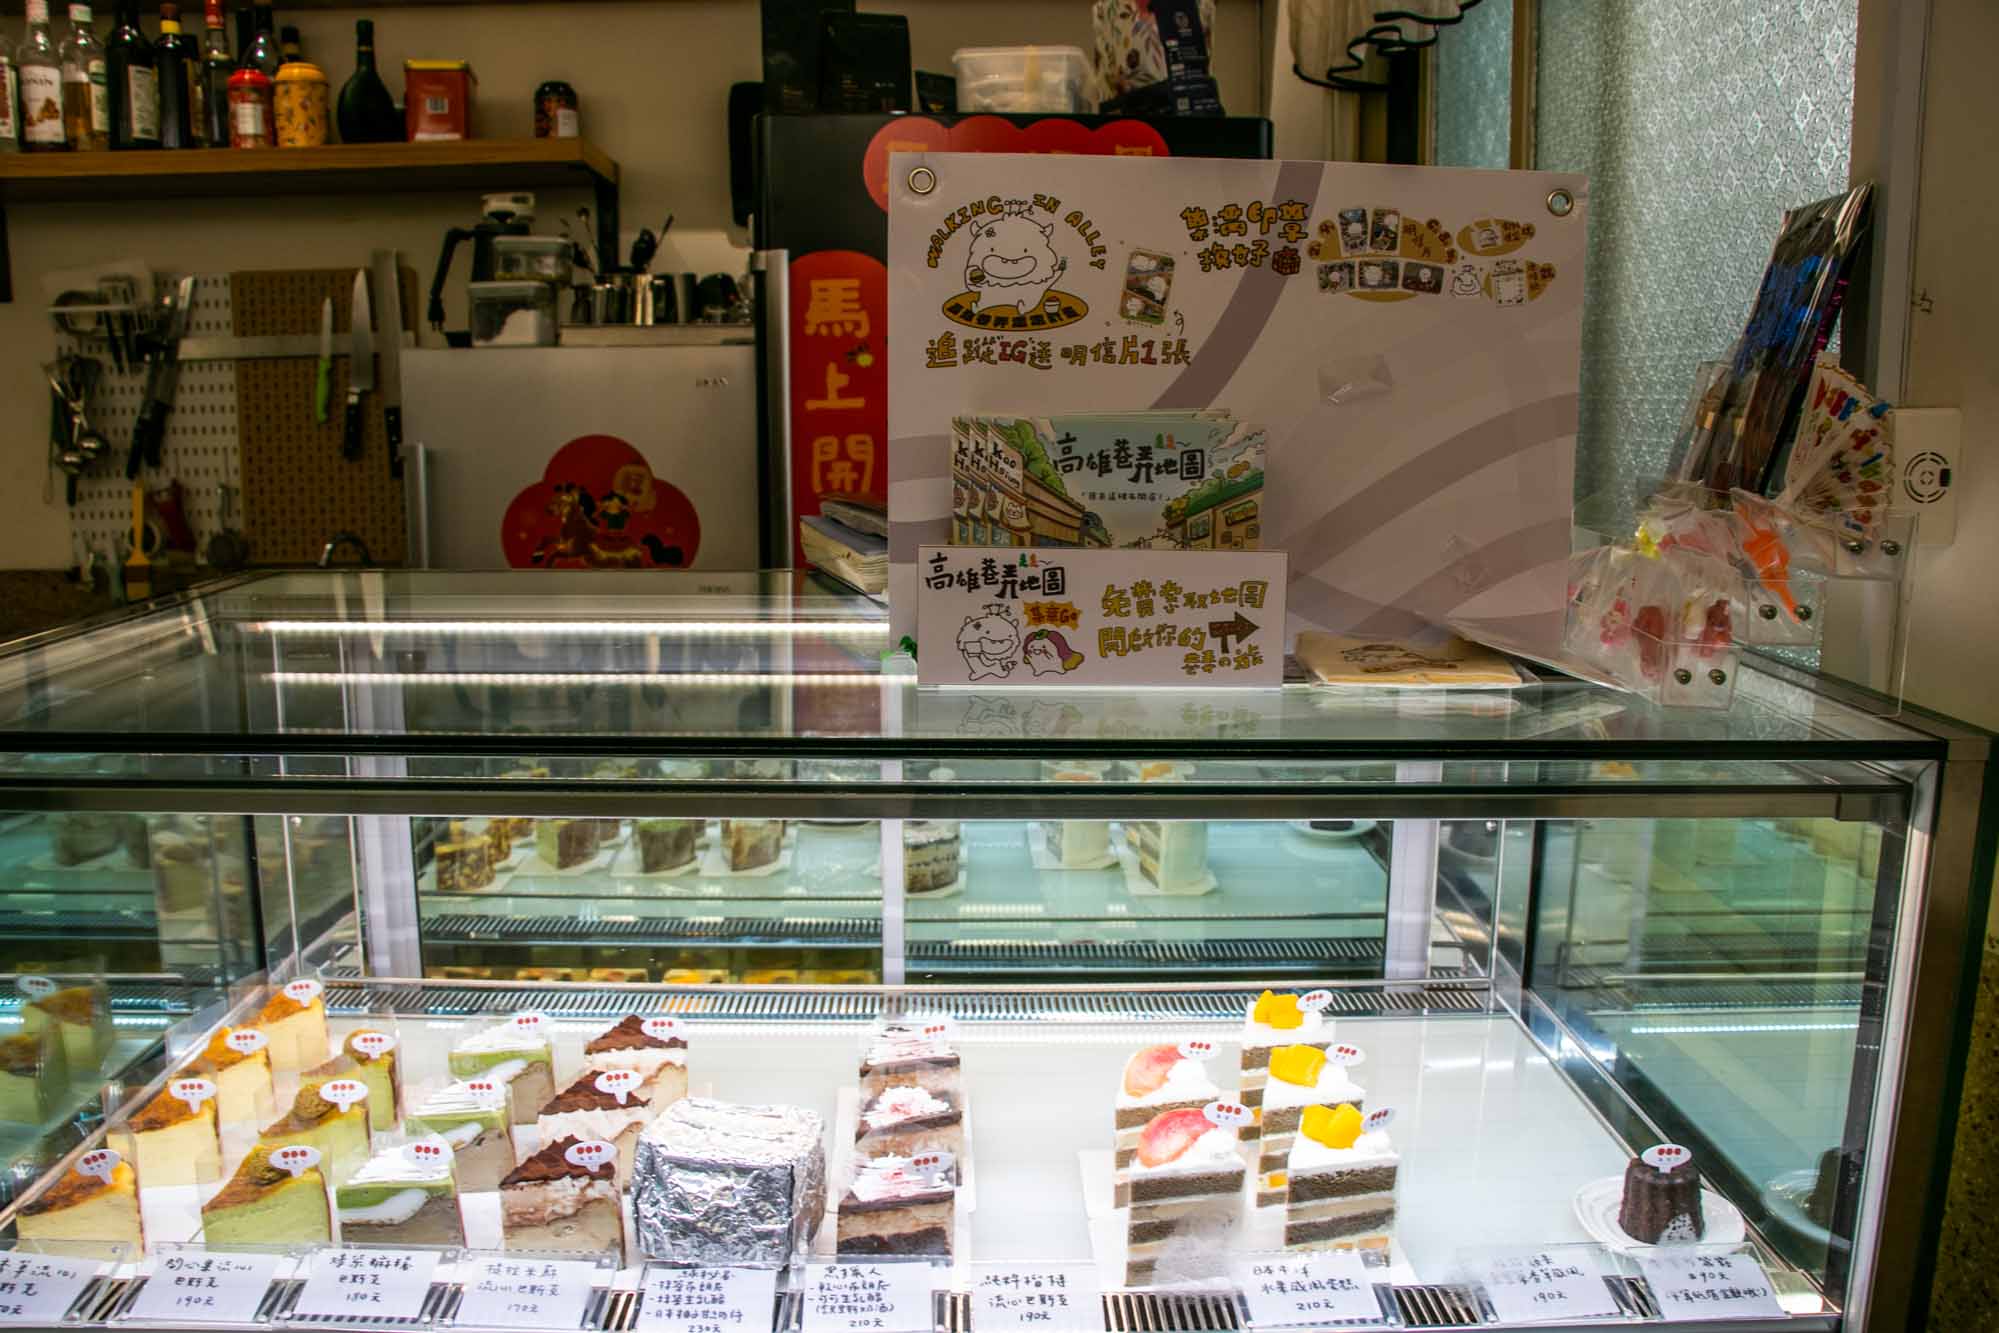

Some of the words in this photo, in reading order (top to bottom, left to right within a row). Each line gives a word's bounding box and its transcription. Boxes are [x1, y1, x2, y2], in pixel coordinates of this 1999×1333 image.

[927, 196, 1004, 268] WALKING
[1032, 194, 1061, 213] IN
[1065, 211, 1107, 270] ALLEY
[1054, 432, 1206, 484] 高雄巷弄地圖
[926, 552, 1066, 600] 高雄巷弄地圖
[1101, 580, 1269, 618] 免費索取地圖
[1098, 623, 1207, 658] 開啟你的
[176, 1295, 215, 1308] 190元
[1019, 1312, 1051, 1322] 190元
[1296, 1299, 1335, 1310] 210元
[849, 1318, 885, 1328] 210元
